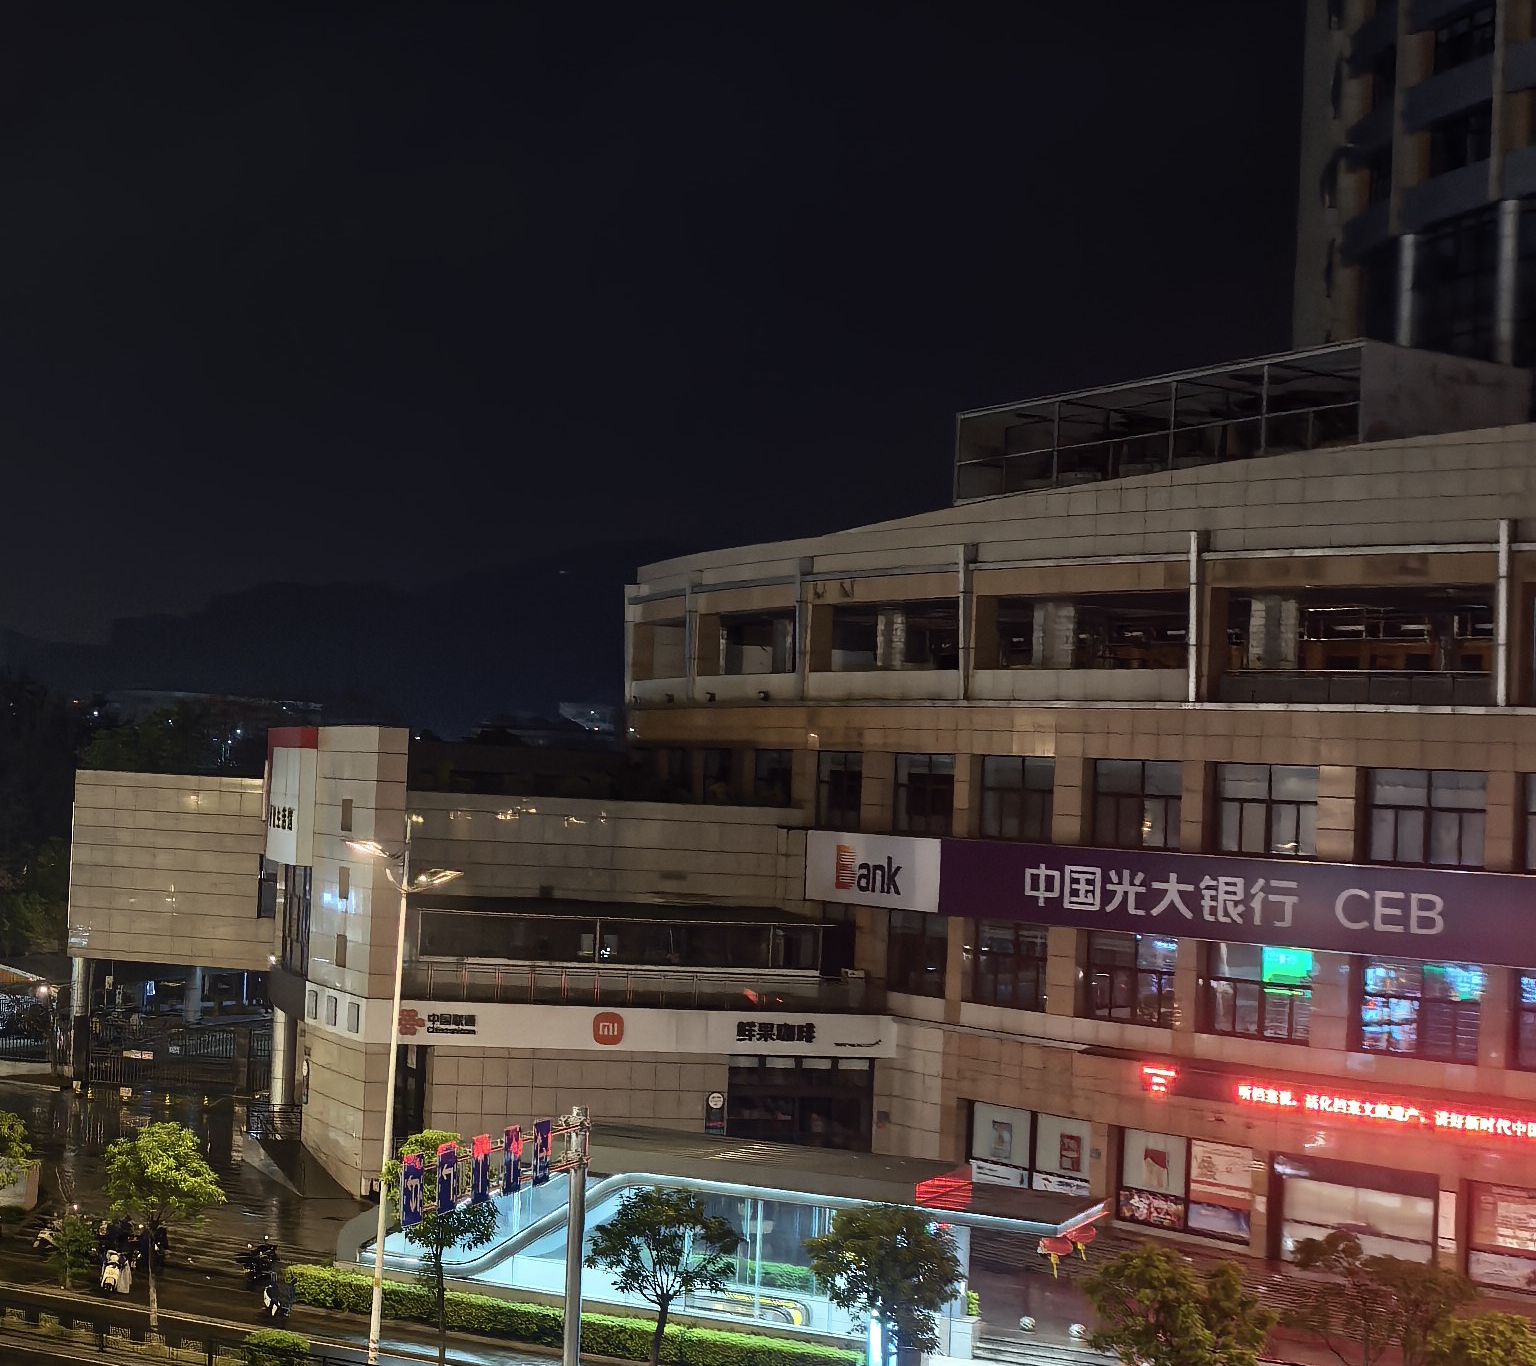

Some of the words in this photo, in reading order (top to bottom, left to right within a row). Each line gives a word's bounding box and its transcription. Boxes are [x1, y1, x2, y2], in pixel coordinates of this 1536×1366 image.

[835, 844, 903, 896] Bank
[1024, 863, 1299, 928] 中国光大银行
[1334, 887, 1444, 935] CEB
